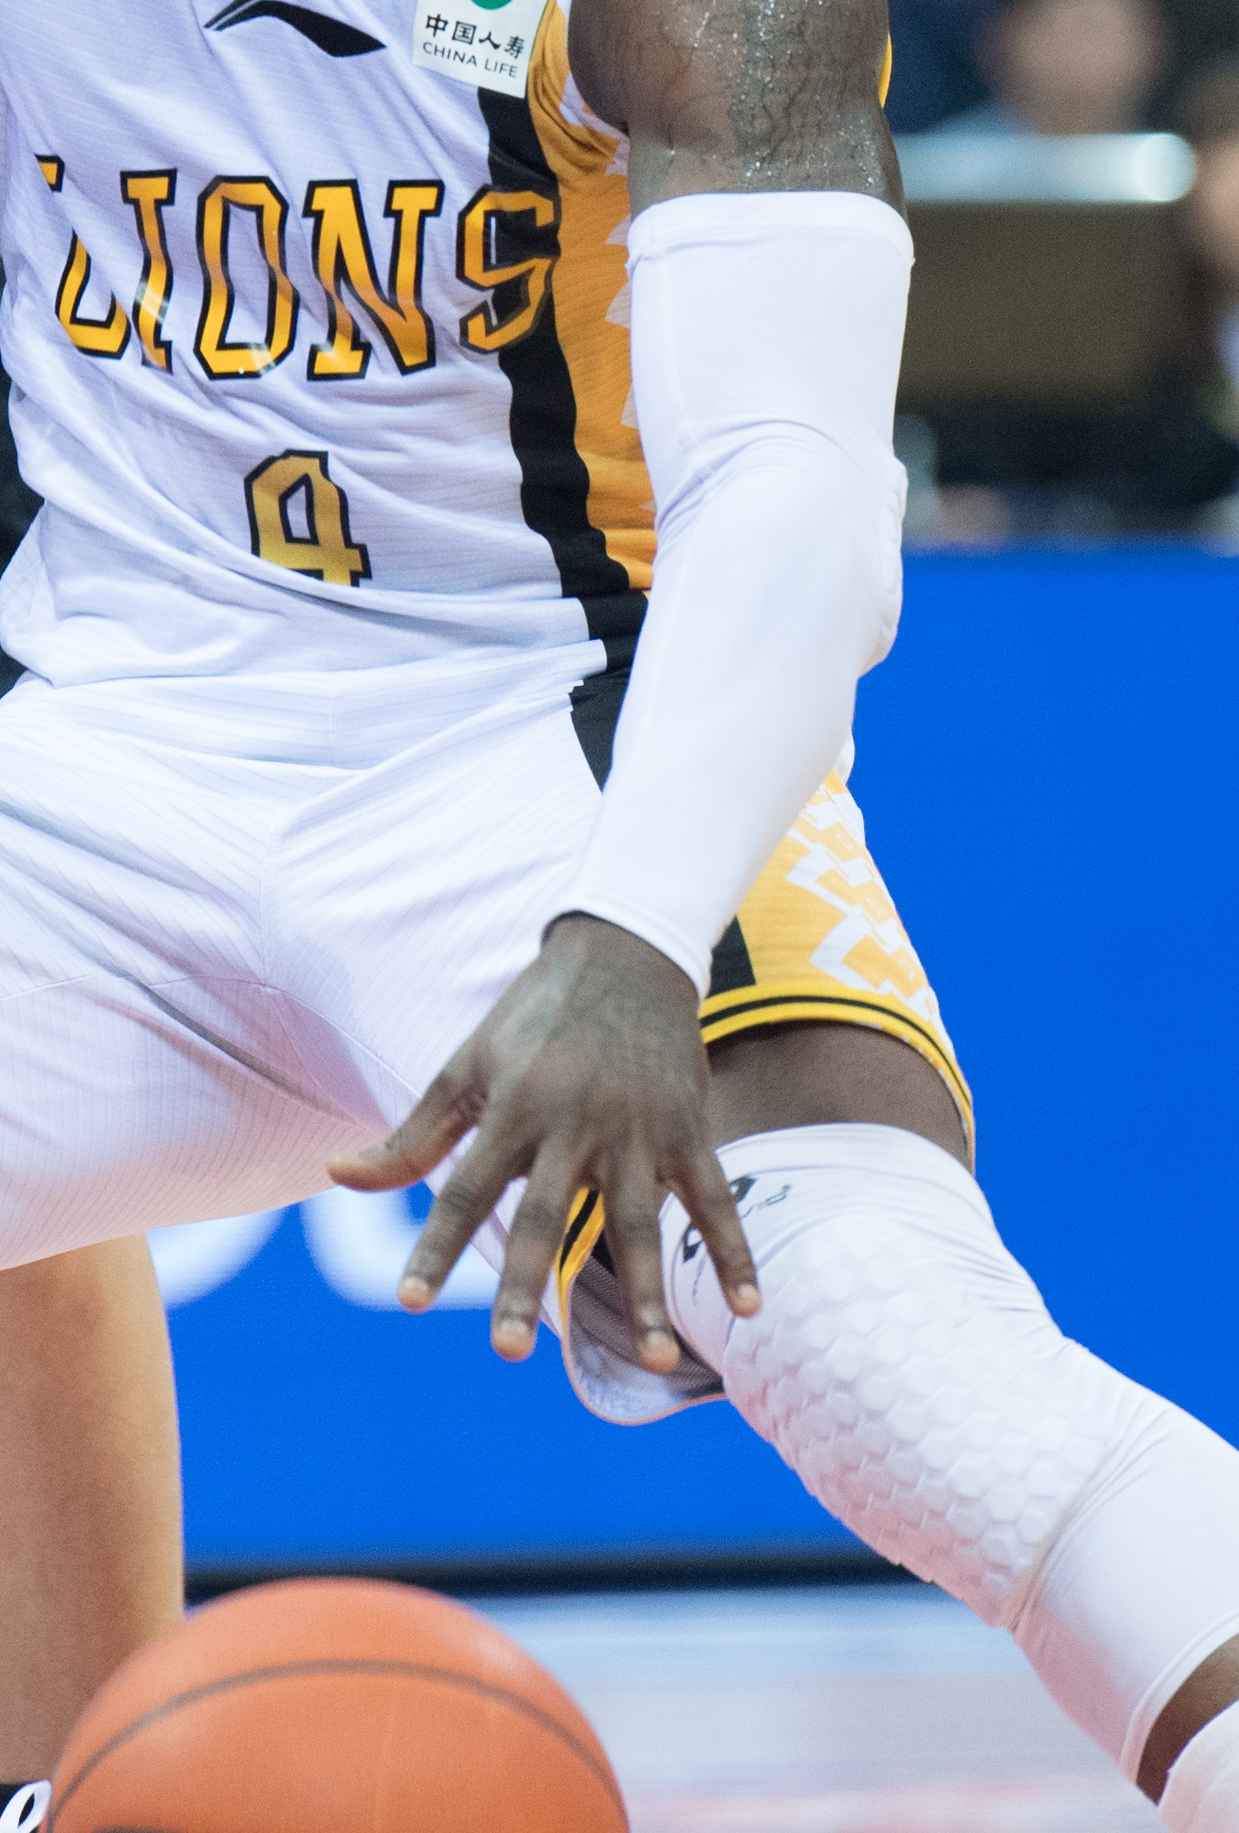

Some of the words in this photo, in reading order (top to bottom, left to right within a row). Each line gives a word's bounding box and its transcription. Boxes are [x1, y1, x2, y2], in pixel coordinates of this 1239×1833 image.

[422, 41, 477, 67] CHINA
[484, 58, 518, 78] LIFE
[425, 14, 525, 59] 中国人寿
[36, 154, 560, 381] LIONS
[244, 449, 371, 588] 4
